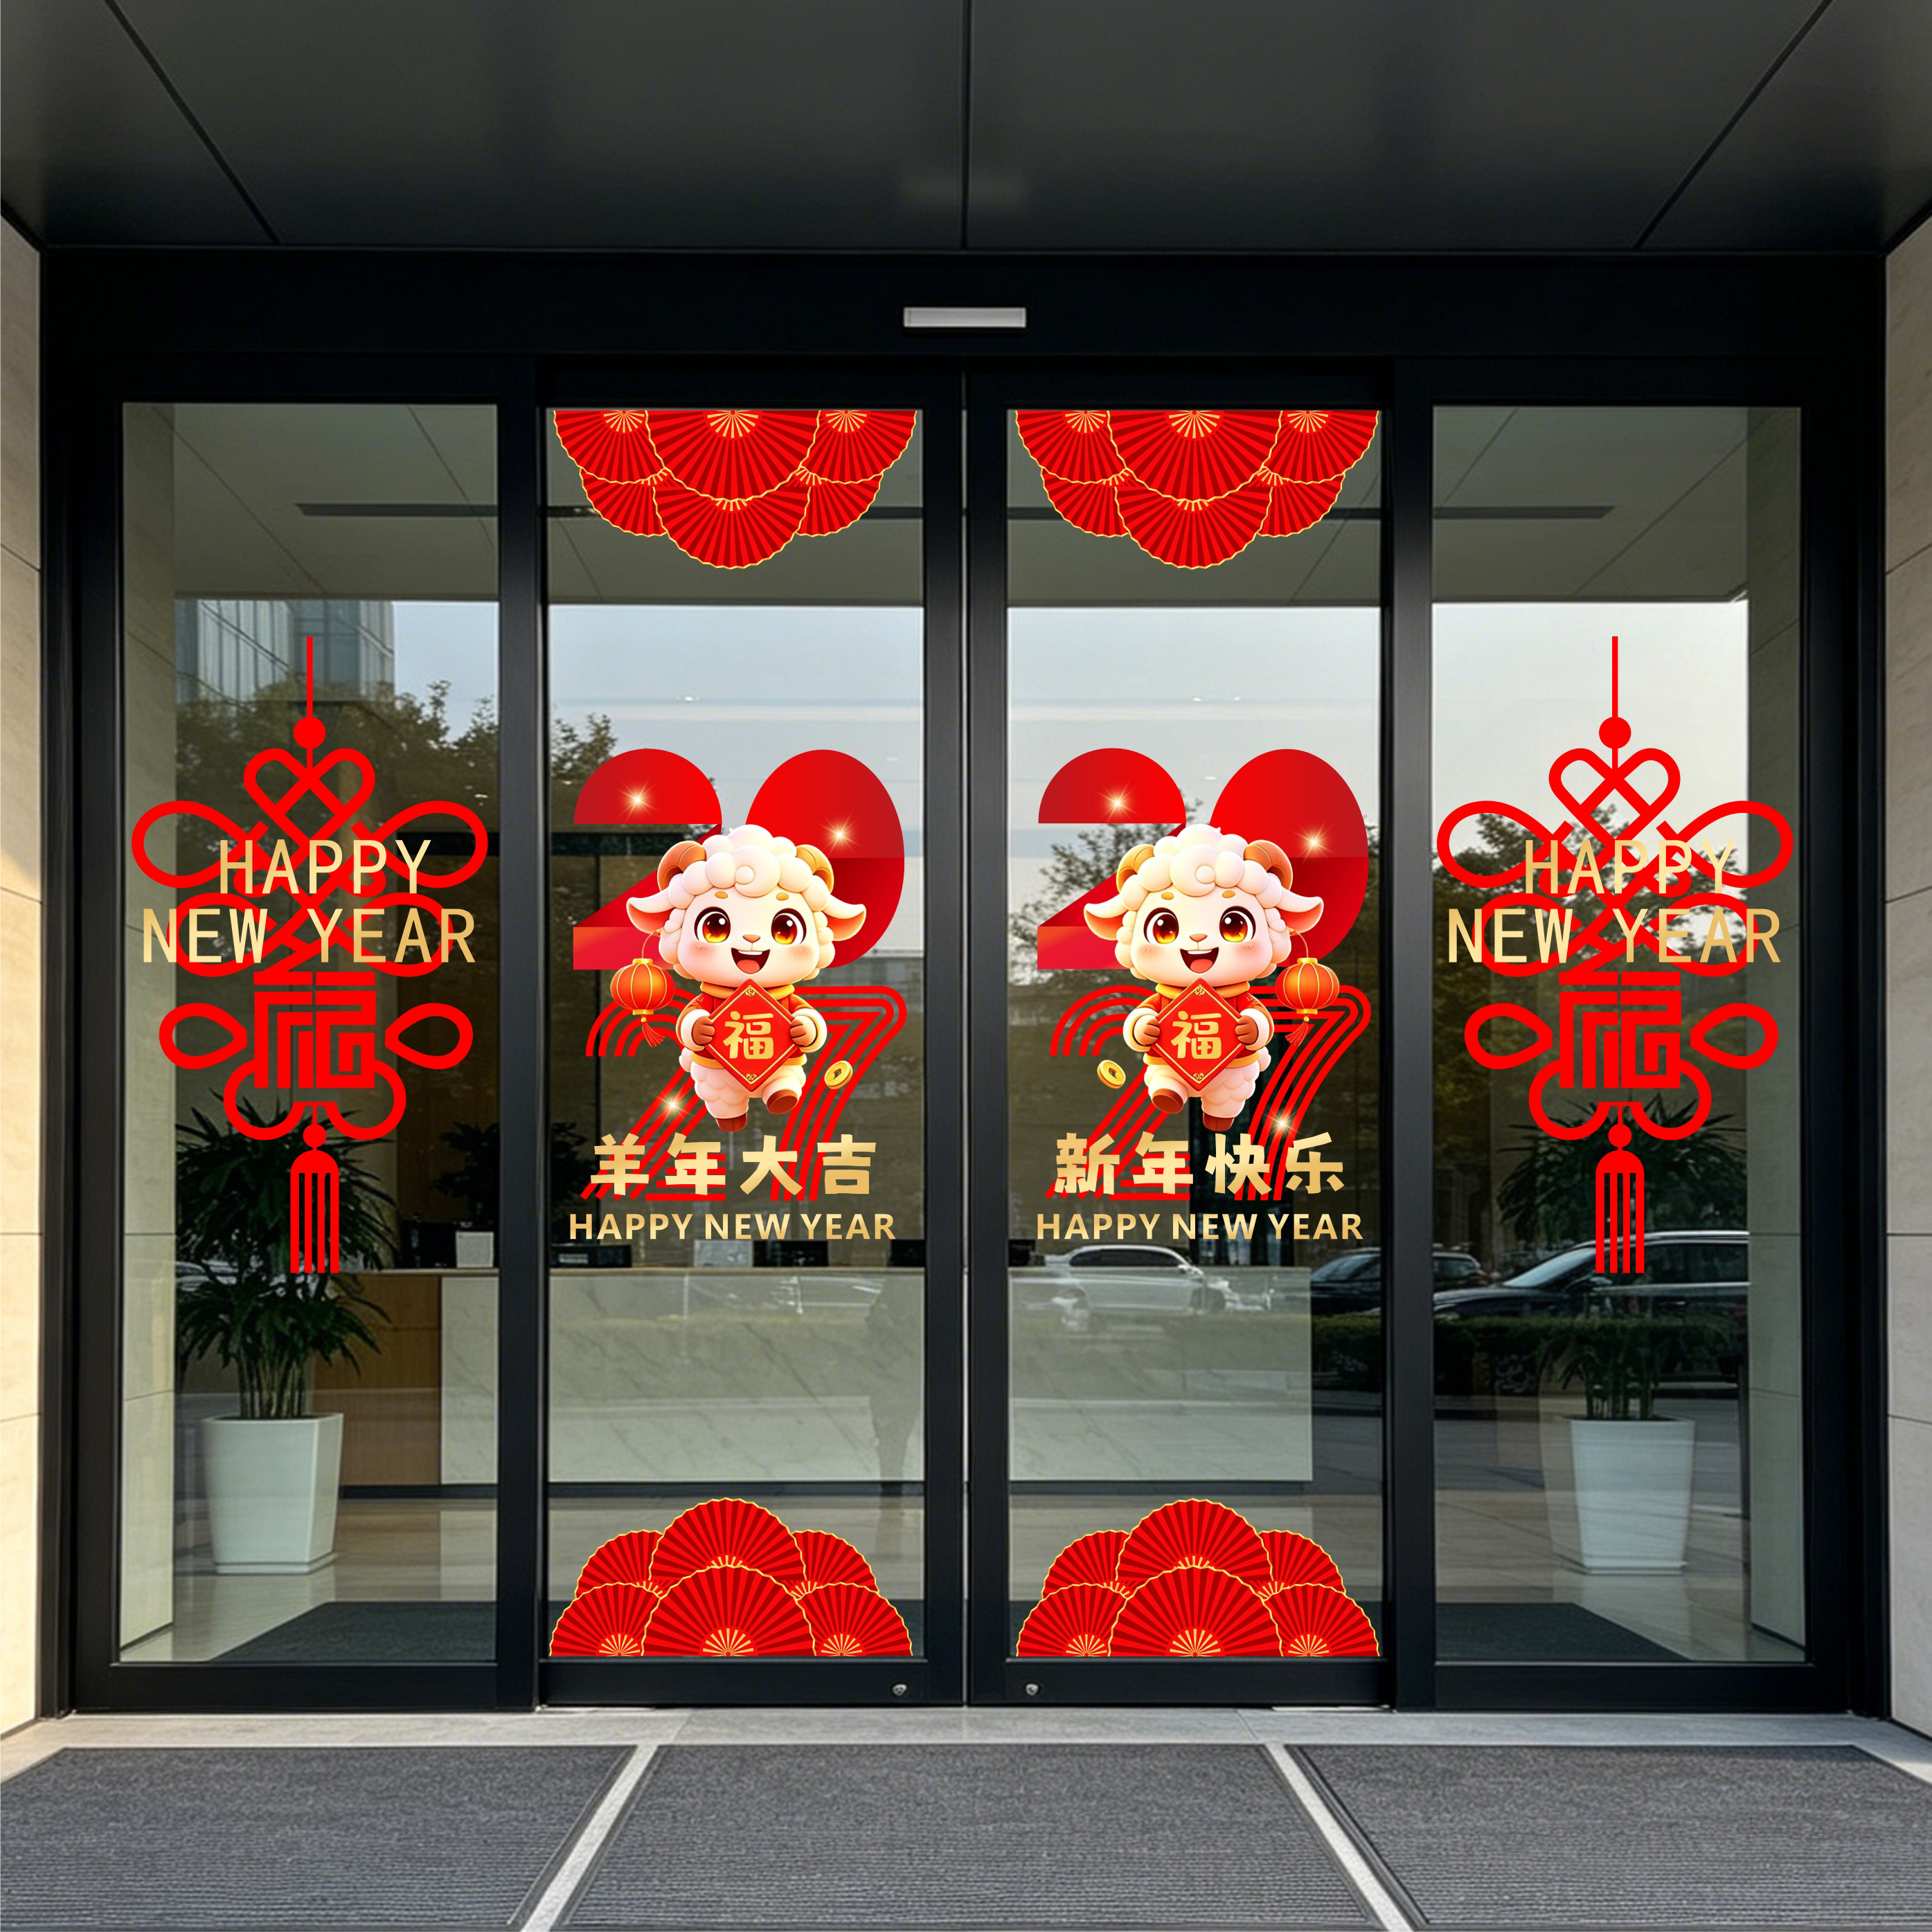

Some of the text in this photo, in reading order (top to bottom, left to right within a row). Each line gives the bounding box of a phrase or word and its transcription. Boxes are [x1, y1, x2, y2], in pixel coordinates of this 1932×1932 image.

[219, 839, 431, 894] HAPPY
[1524, 839, 1737, 894] HAPPY
[143, 908, 476, 964] NEW YEAR
[1448, 908, 1781, 964] NEW YEAR
[722, 1010, 775, 1060] 福
[1171, 1010, 1223, 1060] 福
[590, 1133, 877, 1196] 羊年大吉
[1053, 1132, 1345, 1195] 新年快乐
[569, 1214, 896, 1240] HAPPY NEW YEAR
[1037, 1214, 1363, 1240] HAPPY NEW YEAR
